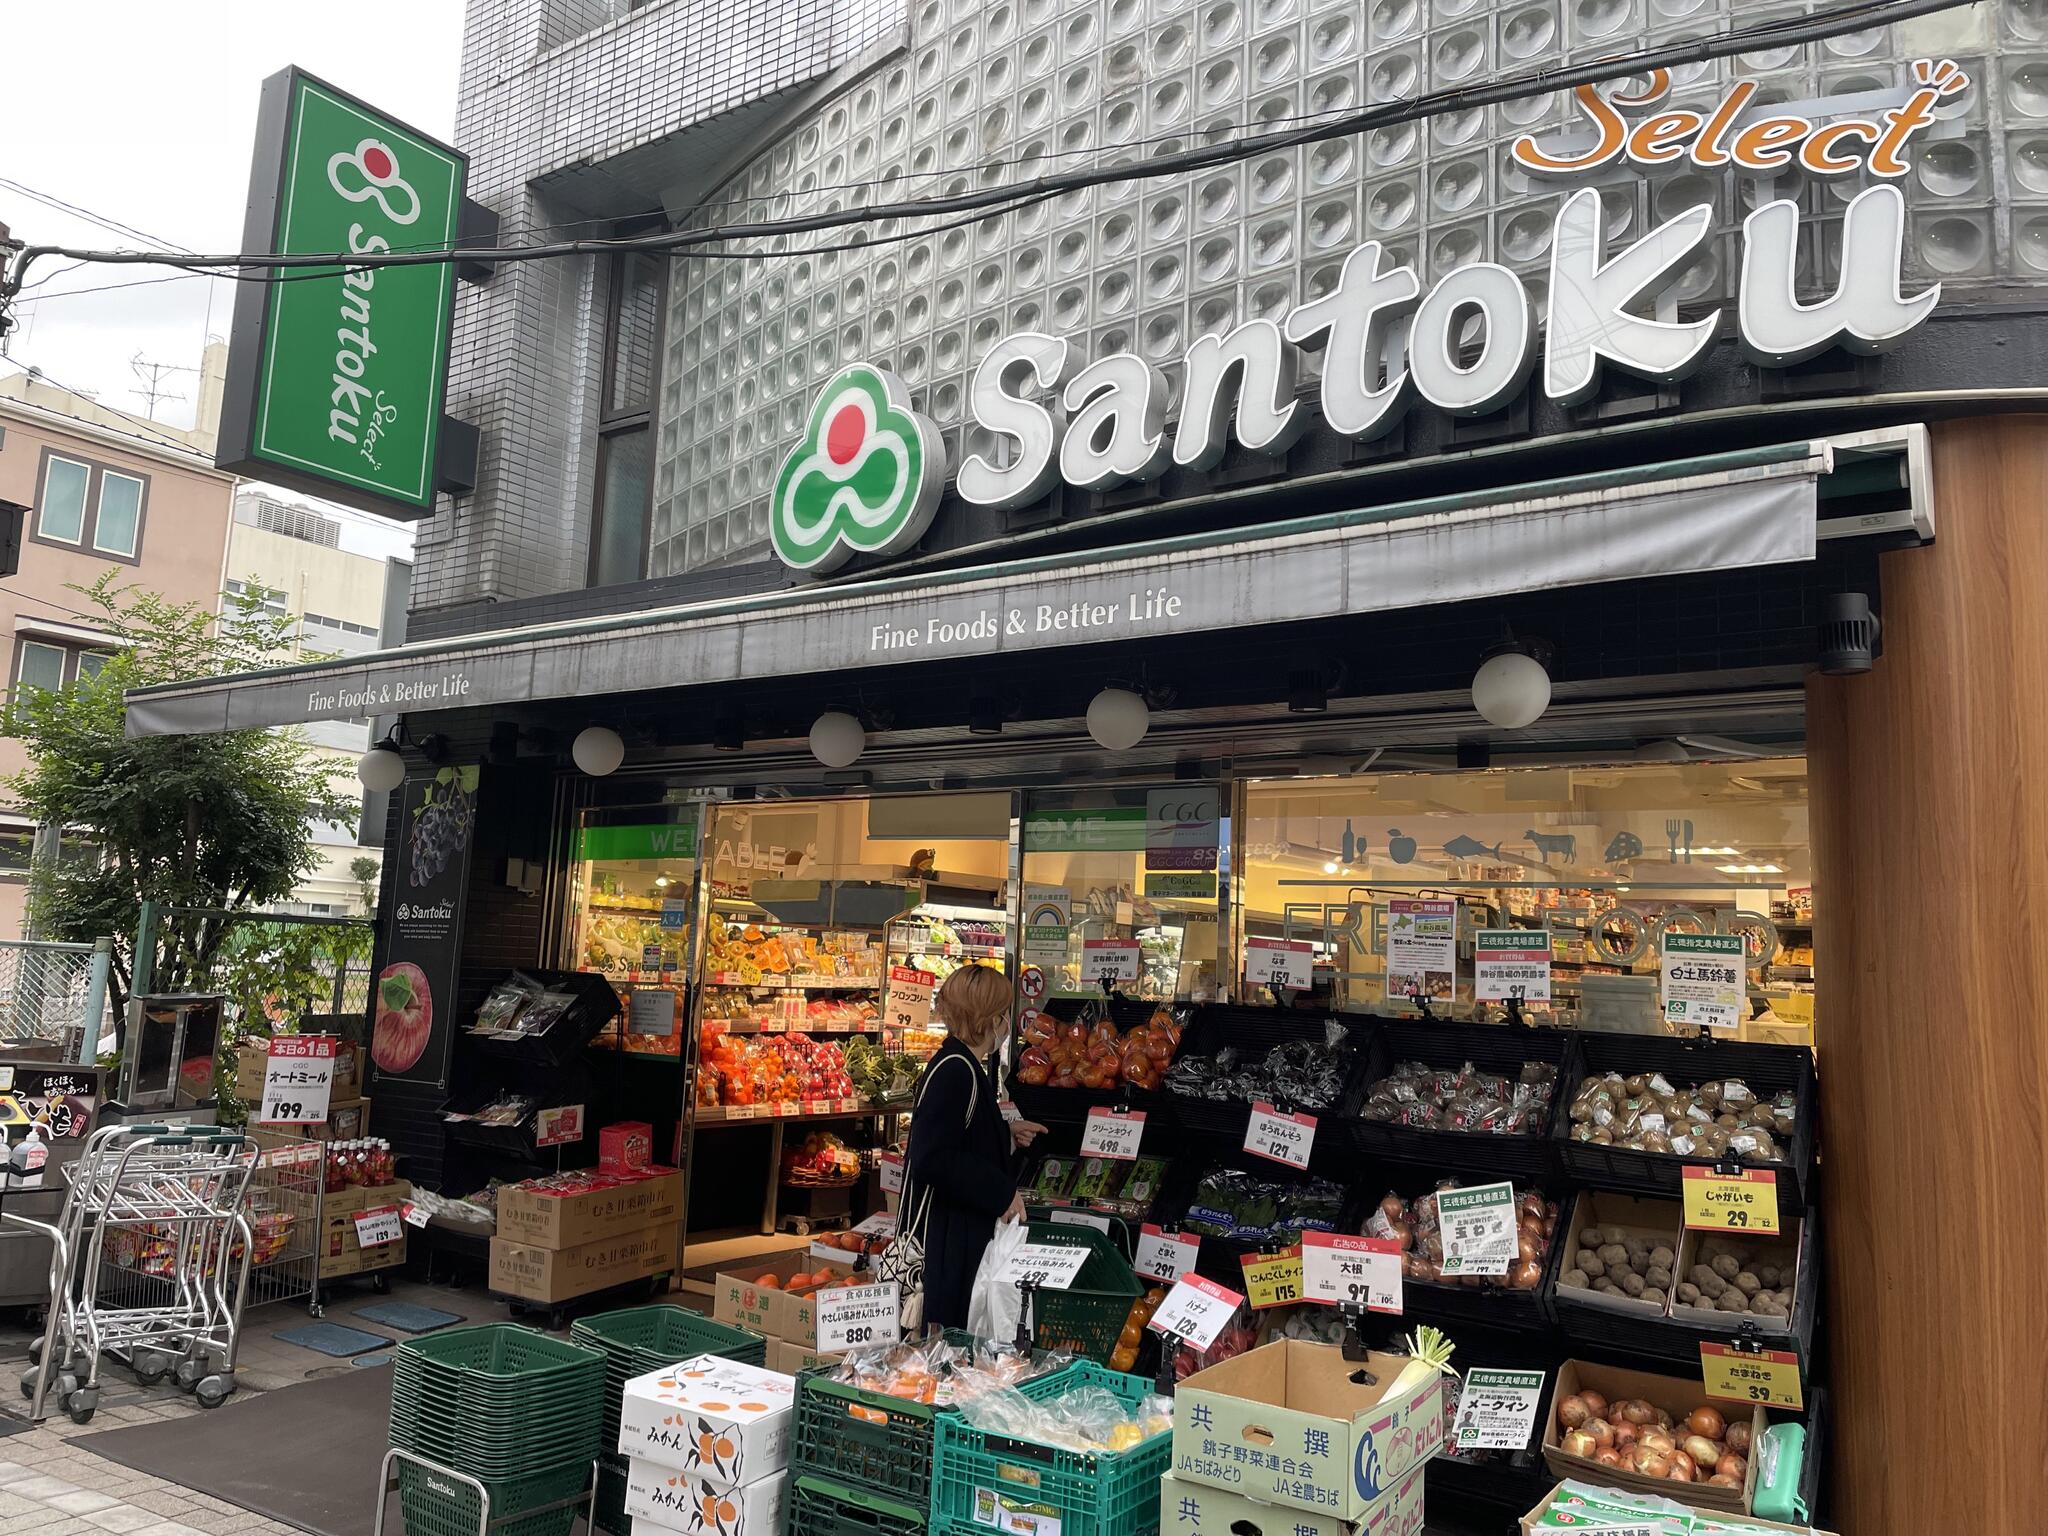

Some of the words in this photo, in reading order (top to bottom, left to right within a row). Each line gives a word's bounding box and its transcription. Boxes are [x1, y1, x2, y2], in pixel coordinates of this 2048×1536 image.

[1512, 62, 1940, 176] Select
[329, 222, 388, 446] Santoku
[955, 184, 1943, 508] Santoku
[360, 390, 398, 468] Select
[870, 622, 919, 651] Fine
[926, 610, 998, 645] Foods
[1005, 608, 1027, 636] &
[1035, 602, 1120, 633] Better
[1128, 587, 1182, 622] Life
[307, 691, 335, 712] Fine
[337, 684, 377, 709] Foods
[379, 683, 391, 704] &
[394, 680, 439, 702] Better
[441, 673, 470, 697] Life
[1159, 801, 1212, 823] CGC
[1148, 855, 1174, 868] CGC
[1174, 854, 1216, 868] GROUP
[411, 905, 452, 919] Santoku
[1481, 936, 1544, 946] 三徳指定農場直送
[1668, 938, 1740, 950] 三徳指定農場直送
[1270, 957, 1287, 966] なす
[895, 972, 932, 985] 本日の1品
[1100, 967, 1120, 979] 399
[1270, 971, 1290, 984] 157
[1669, 966, 1737, 984] 白土馬鈴薯
[891, 990, 928, 1003] ブロッコリー
[1509, 984, 1526, 999] 97
[896, 1013, 912, 1026] 99
[1707, 1015, 1718, 1024] 39
[274, 1040, 330, 1057] 本日の1品
[43, 1075, 74, 1088] ほくほく
[269, 1071, 328, 1084] オートミール
[271, 1102, 303, 1119] 199
[1091, 1124, 1133, 1137] グリーンキウイ
[1259, 1122, 1302, 1142] ほうれんそう
[1099, 1139, 1119, 1153] 498
[1269, 1141, 1290, 1159] 127
[1443, 1190, 1508, 1208] 三徳指定農場直送
[1705, 1190, 1754, 1203] じゃがいも
[1201, 1208, 1234, 1222] ほうれんそう
[1727, 1210, 1748, 1227] 29
[375, 1230, 389, 1242] 139
[1157, 1246, 1177, 1259] とまと
[1332, 1239, 1369, 1251] 広告の品
[1021, 1270, 1050, 1282] 498
[1153, 1262, 1176, 1280] 297
[1340, 1262, 1363, 1275] 大根
[729, 1287, 740, 1304] 共
[845, 1286, 891, 1300] 食卓応援価
[1275, 1284, 1297, 1301] 175
[1347, 1283, 1370, 1303] 97
[1380, 1296, 1394, 1305] 105
[735, 1309, 746, 1321] JA
[799, 1308, 810, 1324] 共
[1174, 1316, 1198, 1337] 128
[845, 1326, 873, 1344] 880
[1472, 1374, 1537, 1386] 三徳指定農場直送
[1729, 1367, 1772, 1381] たまねぎ
[1748, 1385, 1770, 1401] 39
[1467, 1399, 1529, 1413] メークイン
[647, 1426, 684, 1451] みかん
[1190, 1403, 1213, 1433] 共
[1303, 1427, 1330, 1459] 撰
[1413, 1411, 1442, 1461] だいこん
[1494, 1439, 1508, 1447] 197
[1202, 1438, 1314, 1480] 銚子野菜連合会
[1177, 1455, 1242, 1483] JAちばみどり
[426, 1477, 456, 1498] Santoku
[1272, 1477, 1340, 1507] JA全農ちば
[651, 1487, 688, 1513] みかん
[1178, 1496, 1201, 1526] 共
